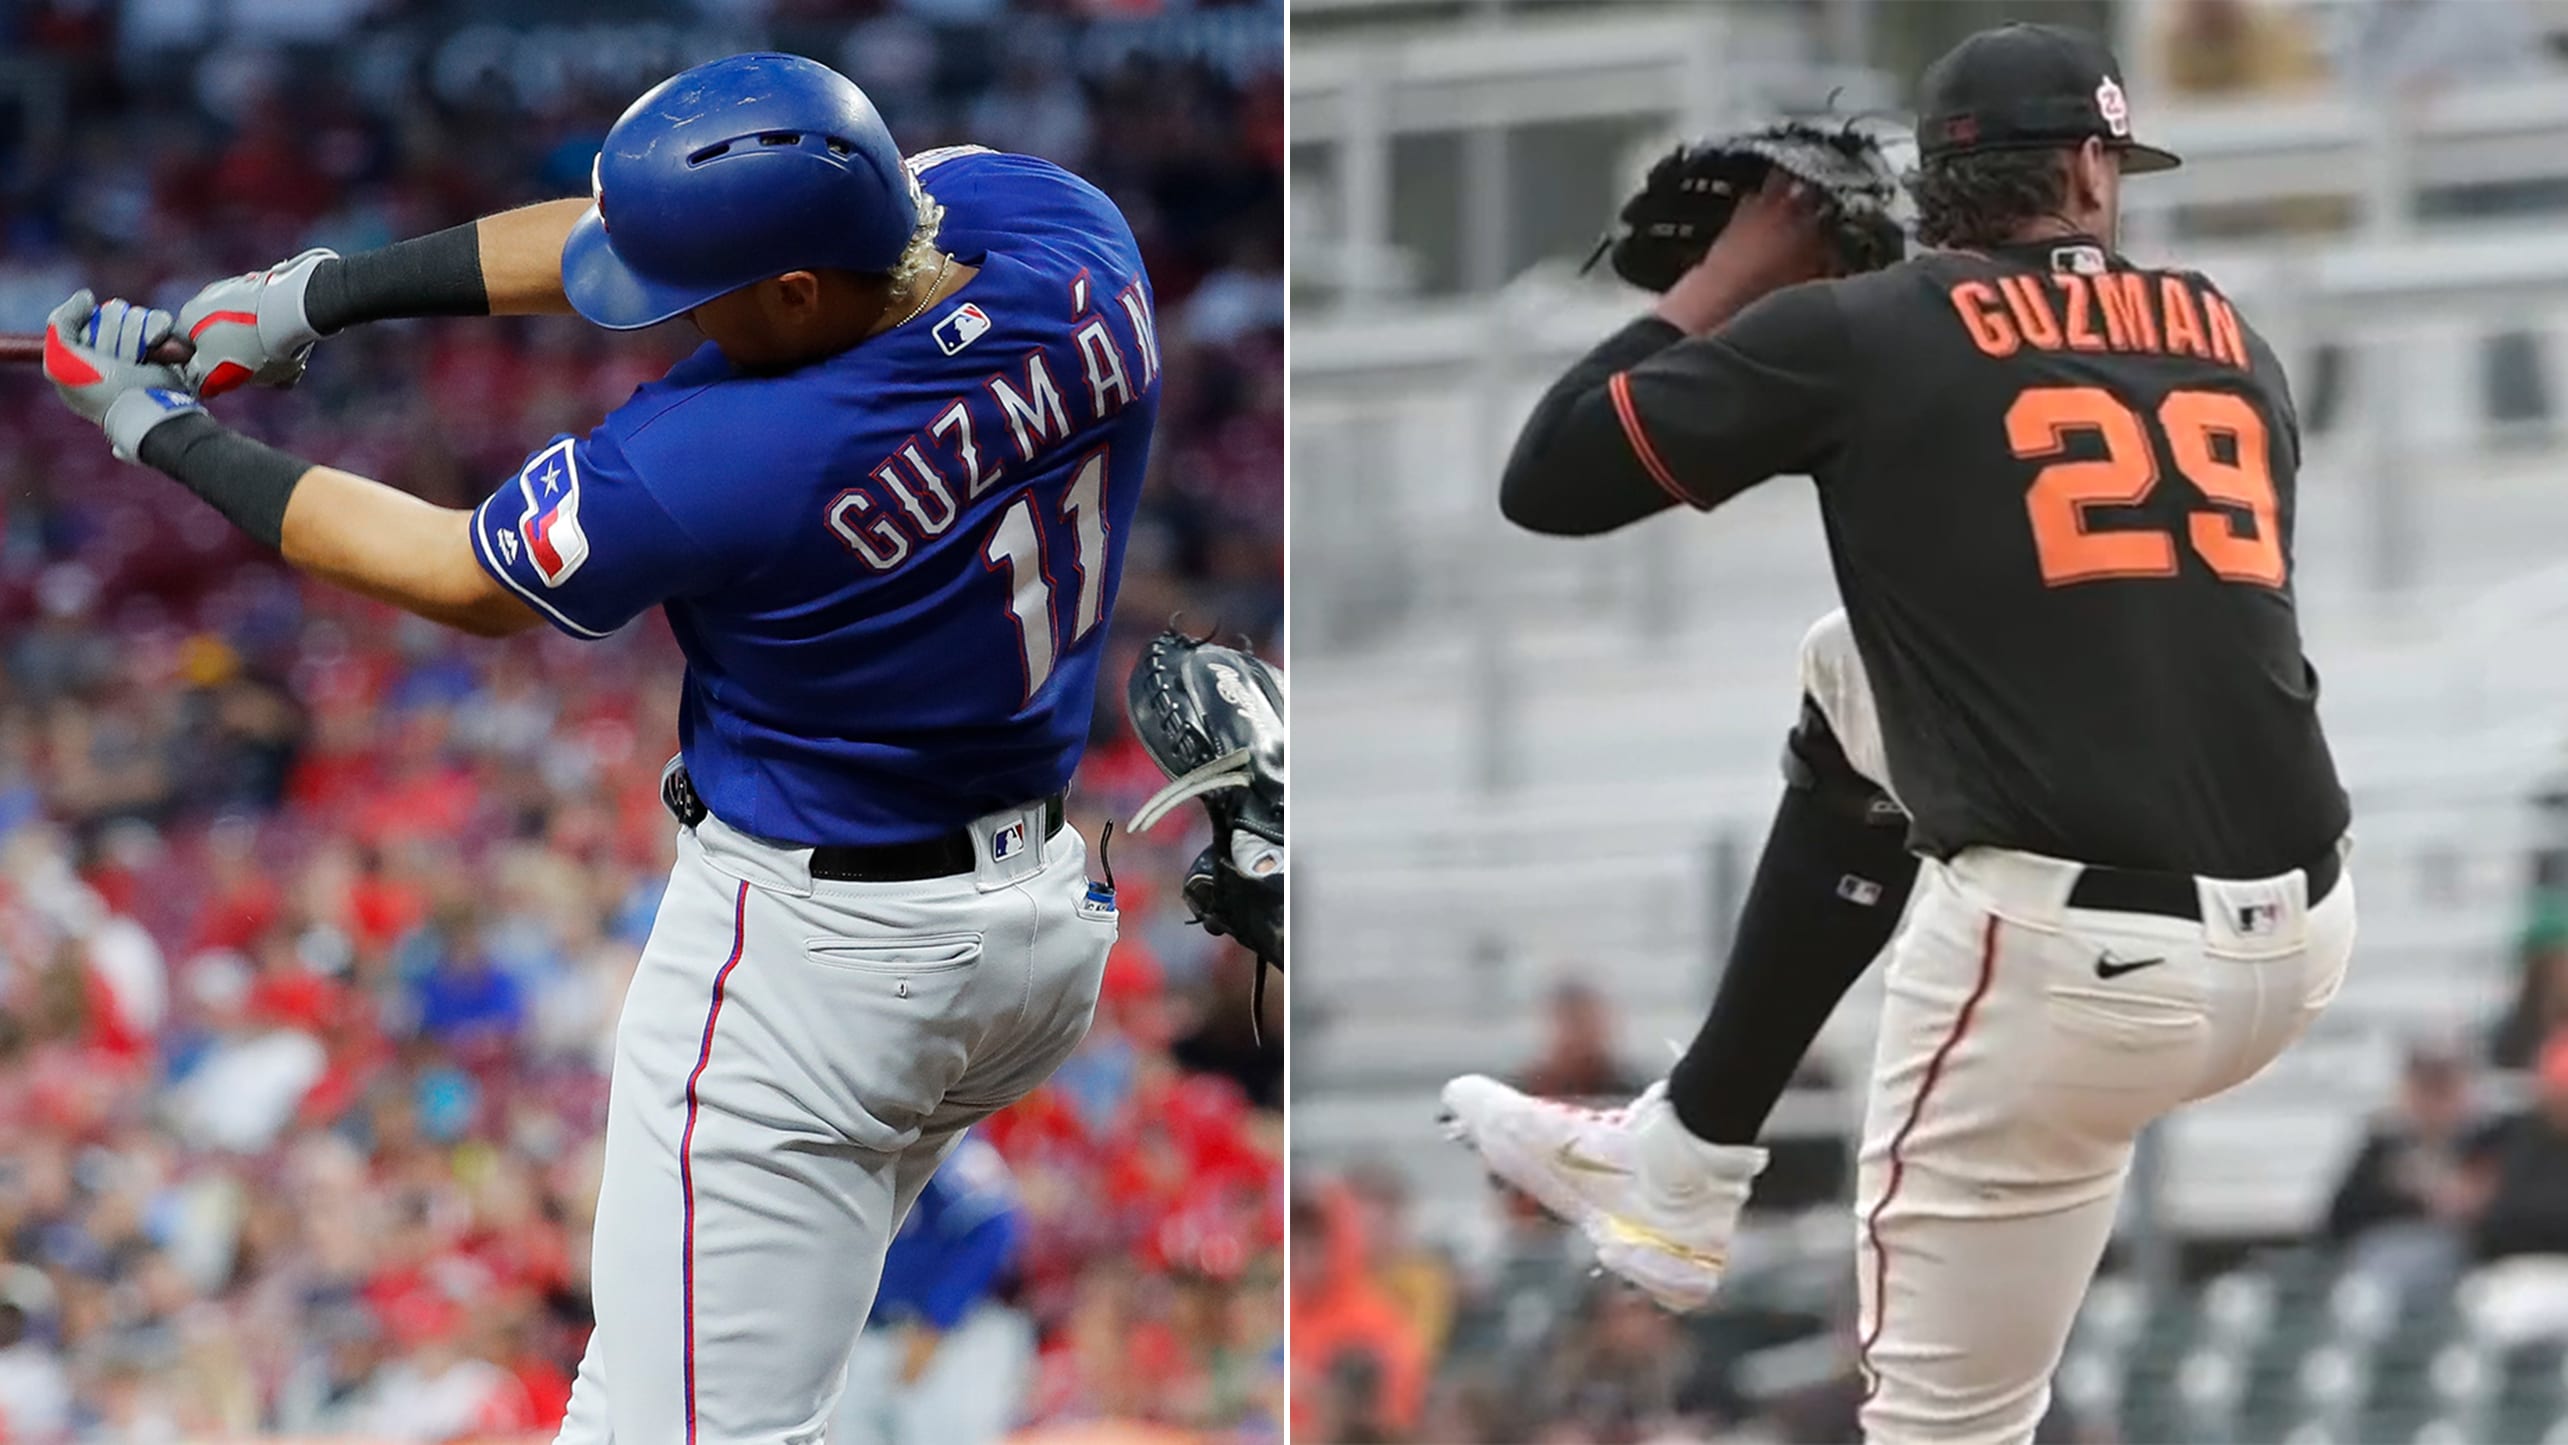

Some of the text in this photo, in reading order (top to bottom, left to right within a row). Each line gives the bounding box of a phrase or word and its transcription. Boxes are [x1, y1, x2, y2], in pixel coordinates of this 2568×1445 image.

[824, 267, 1160, 573] GUZMÁN
[1950, 274, 2251, 372] GUZMAN
[980, 442, 1110, 706] 11
[2004, 386, 2287, 588] 29
